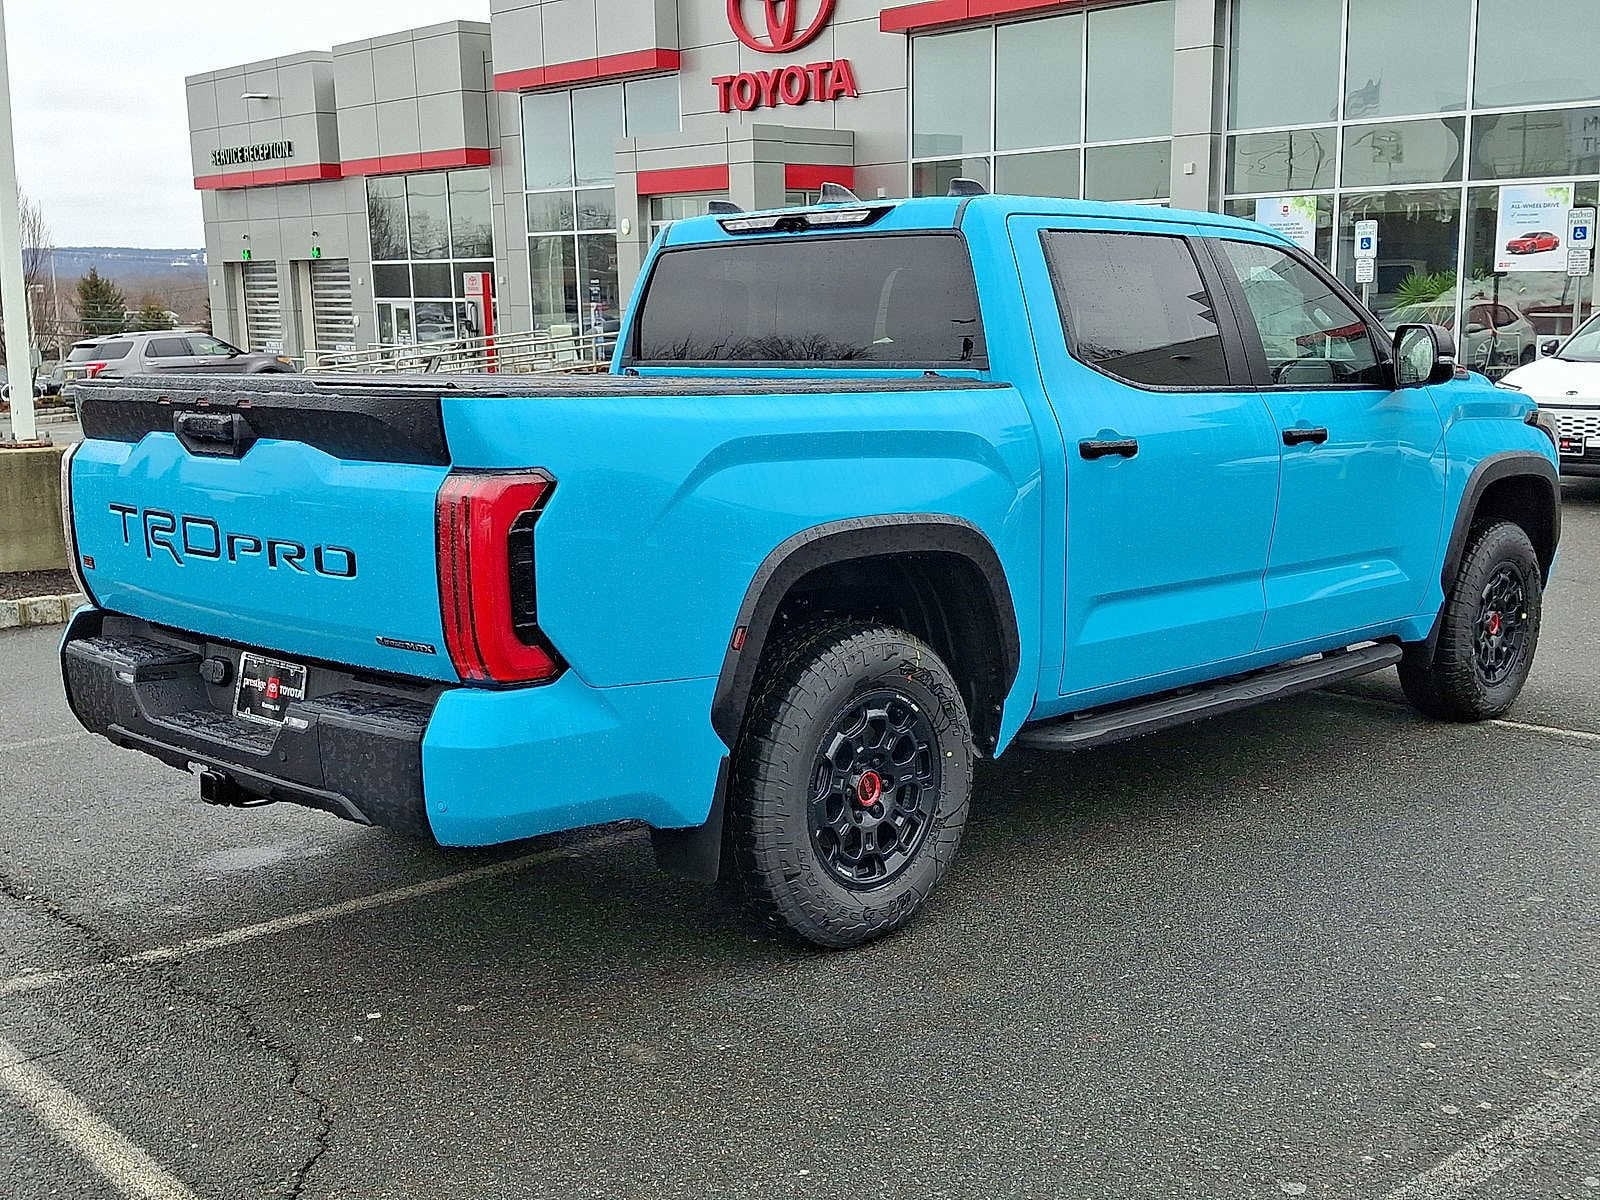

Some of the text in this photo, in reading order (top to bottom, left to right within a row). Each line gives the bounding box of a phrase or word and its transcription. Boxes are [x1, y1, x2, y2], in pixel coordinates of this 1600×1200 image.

[711, 58, 859, 114] TOYOTA
[209, 140, 292, 166] SERVICE RECEPTION
[109, 502, 358, 580] TRD PRO
[242, 677, 304, 700] prestige TOYOTA
